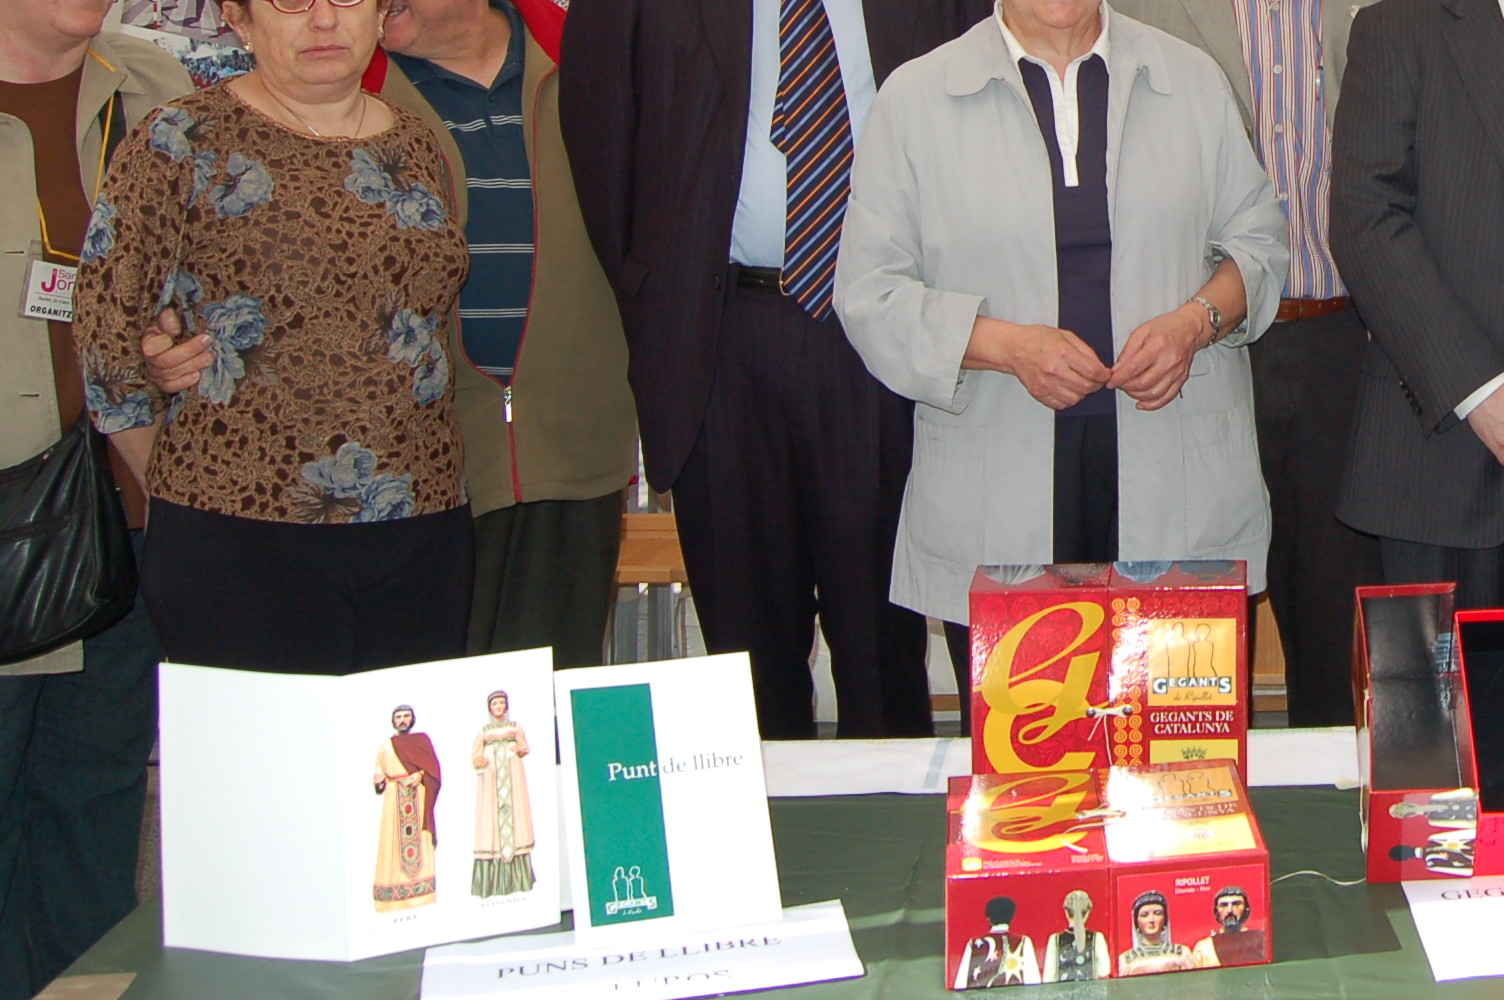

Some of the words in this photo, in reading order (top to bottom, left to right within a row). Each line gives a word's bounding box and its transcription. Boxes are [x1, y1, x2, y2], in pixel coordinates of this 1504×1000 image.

[30, 304, 73, 319] ORGANITZ
[1152, 677, 1232, 695] GEGANTS
[1150, 711, 1213, 723] GEGANTS
[1215, 710, 1235, 722] DE
[1154, 723, 1231, 735] CATALUNYA
[607, 760, 658, 782] Punt
[662, 757, 687, 775] de
[693, 752, 744, 771] llibre
[497, 957, 589, 979] PUNS
[602, 950, 648, 966] DE
[659, 935, 783, 959] LLIBRE
